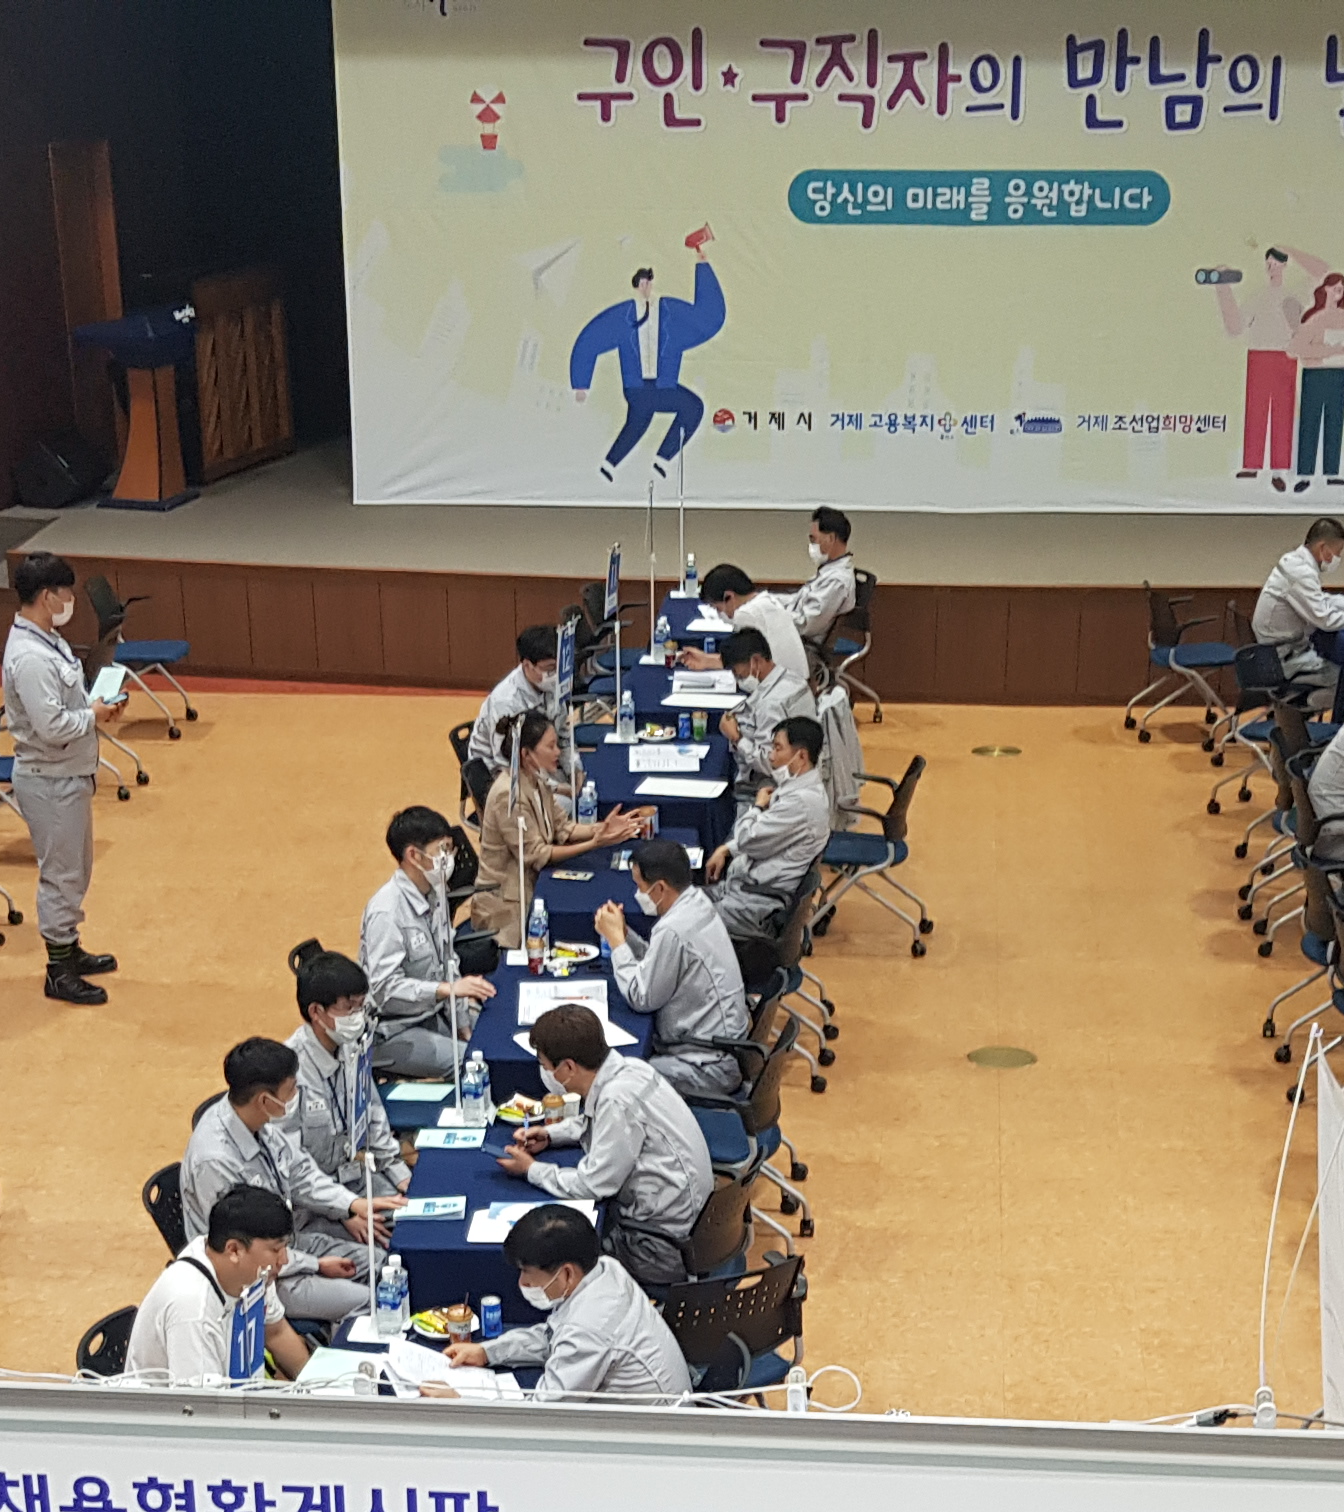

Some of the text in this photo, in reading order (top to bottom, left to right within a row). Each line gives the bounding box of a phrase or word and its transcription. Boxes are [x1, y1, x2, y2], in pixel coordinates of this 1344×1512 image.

[749, 31, 1025, 127] 구직자의
[1064, 28, 1285, 130] 만남의
[806, 177, 1153, 216] 당신의 미래를 응원합니다
[829, 412, 995, 434] 거제 고용복지 센터
[1076, 413, 1227, 434] 거제 조선업희망센터
